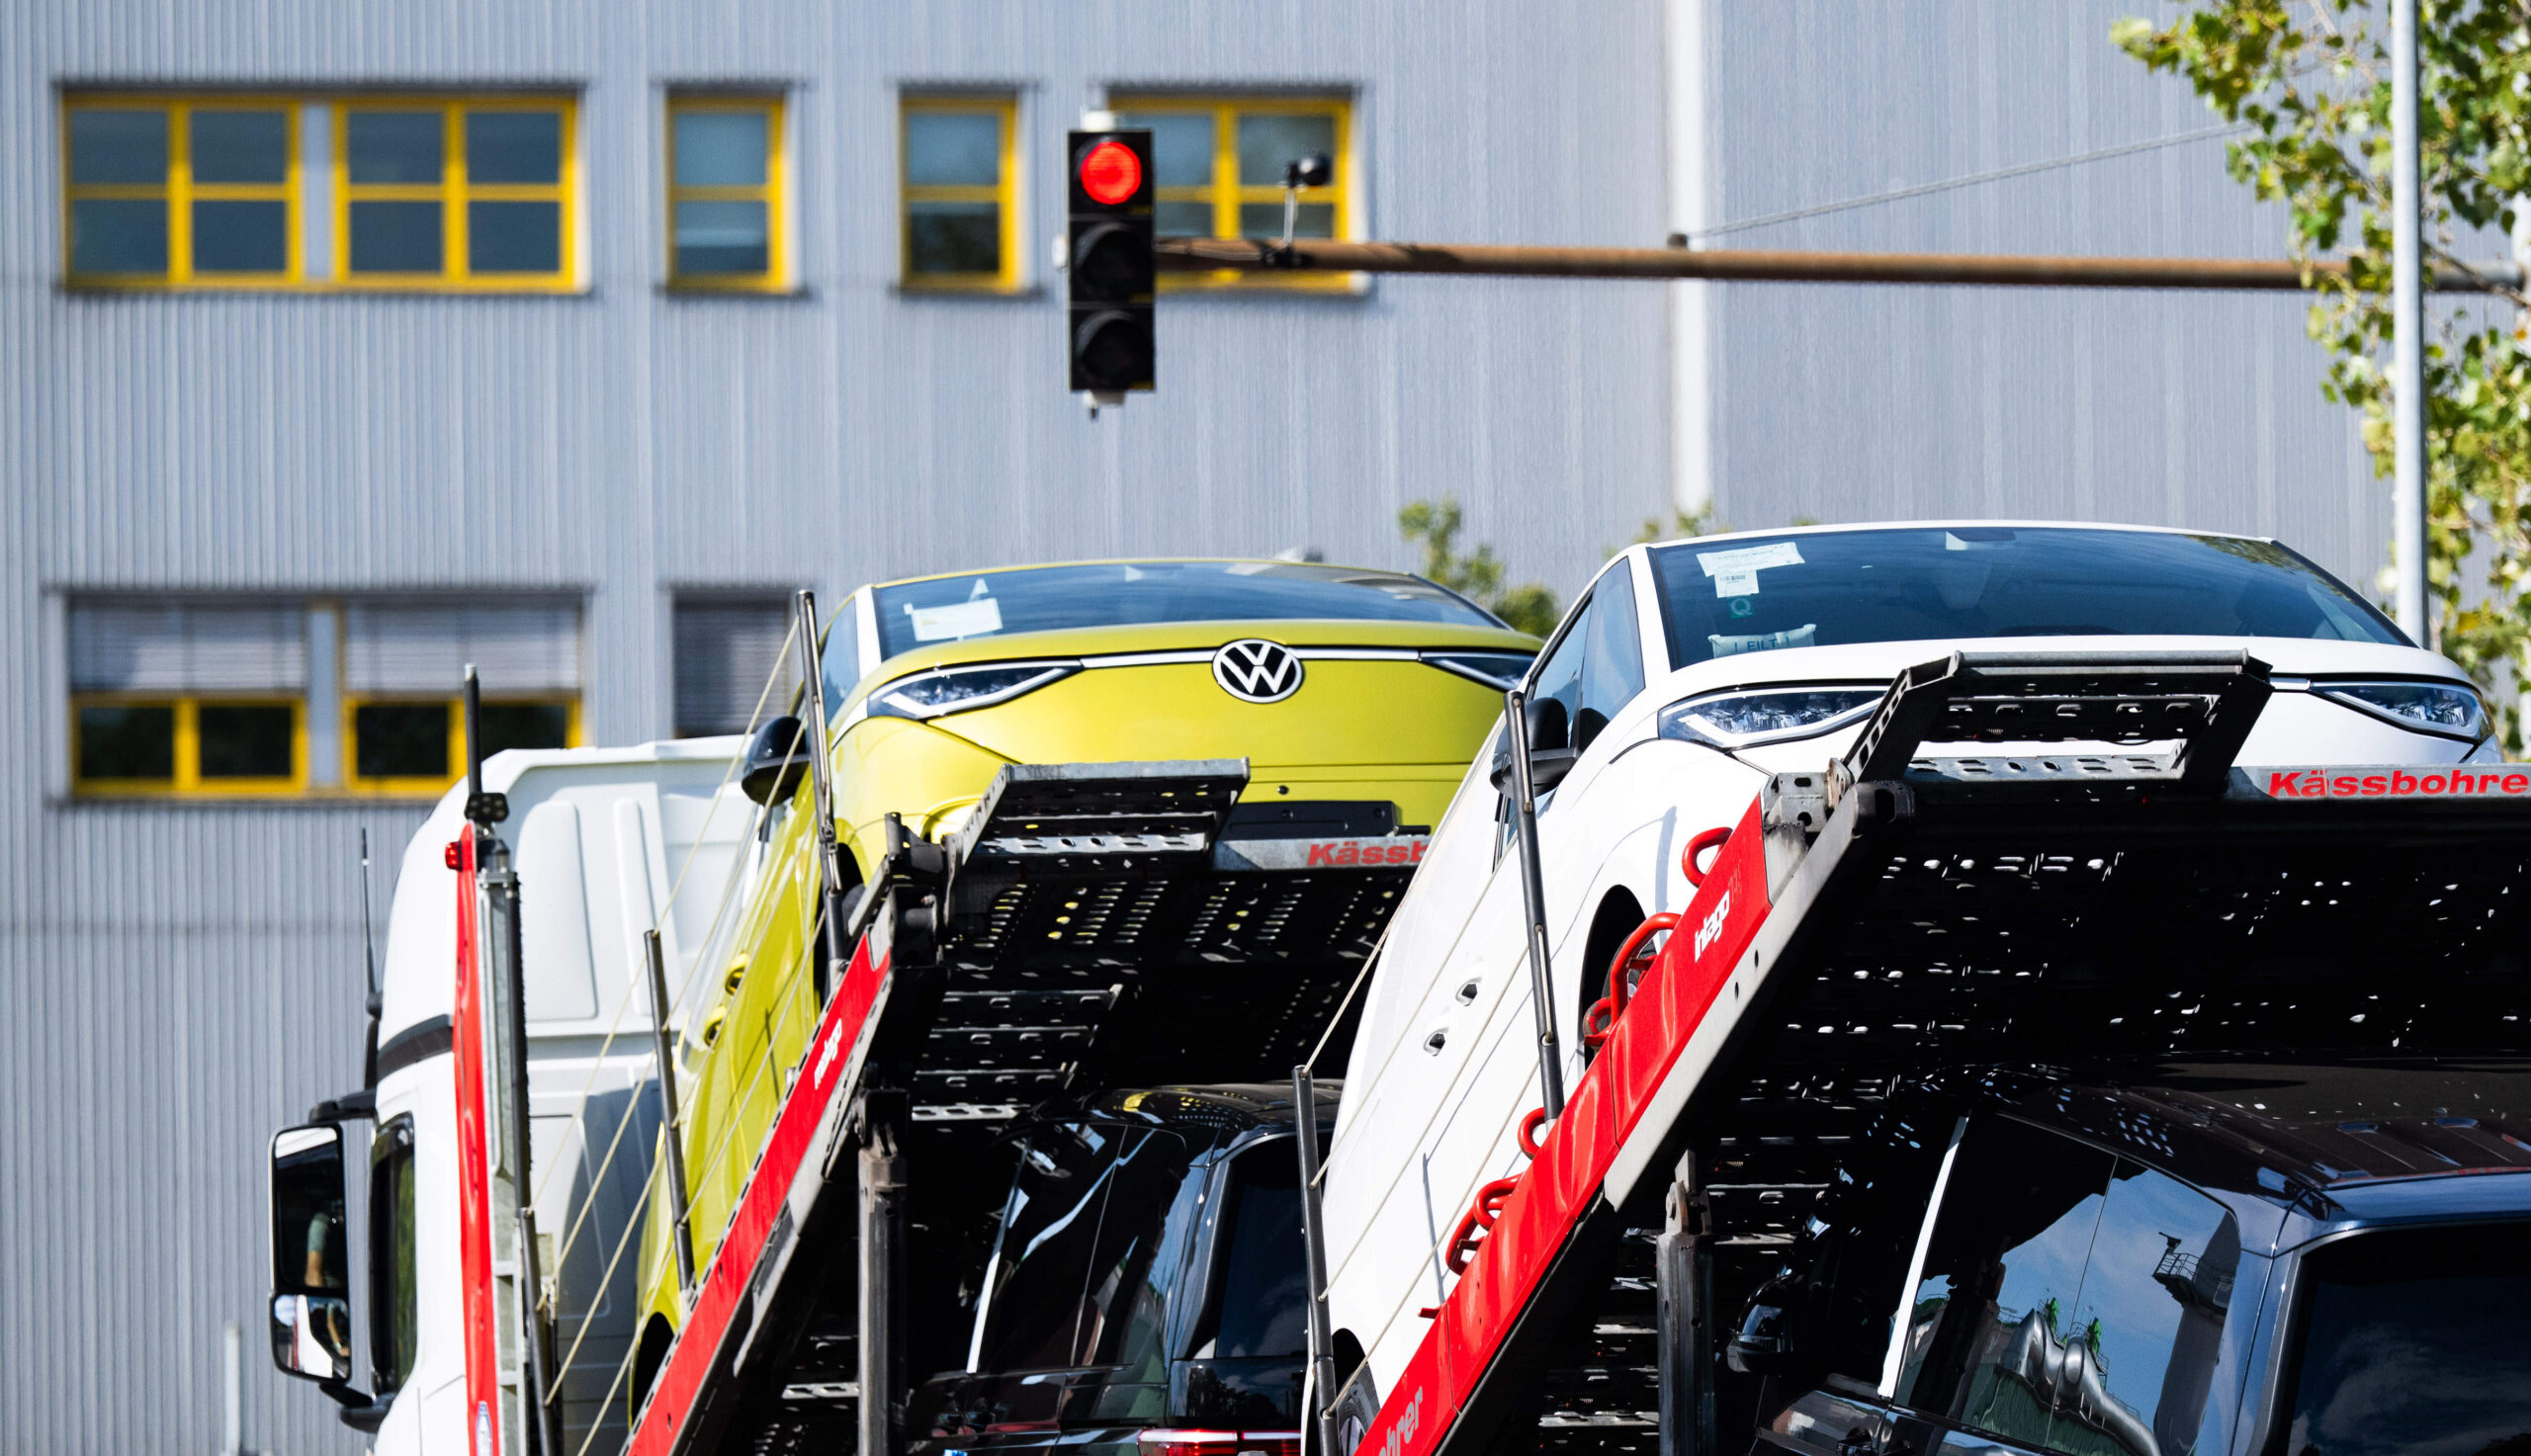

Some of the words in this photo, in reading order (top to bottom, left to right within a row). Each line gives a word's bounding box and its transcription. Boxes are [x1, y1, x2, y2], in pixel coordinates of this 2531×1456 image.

[1730, 596, 1752, 616] Q
[1747, 639, 1778, 651] EILT
[1216, 641, 1297, 699] VW
